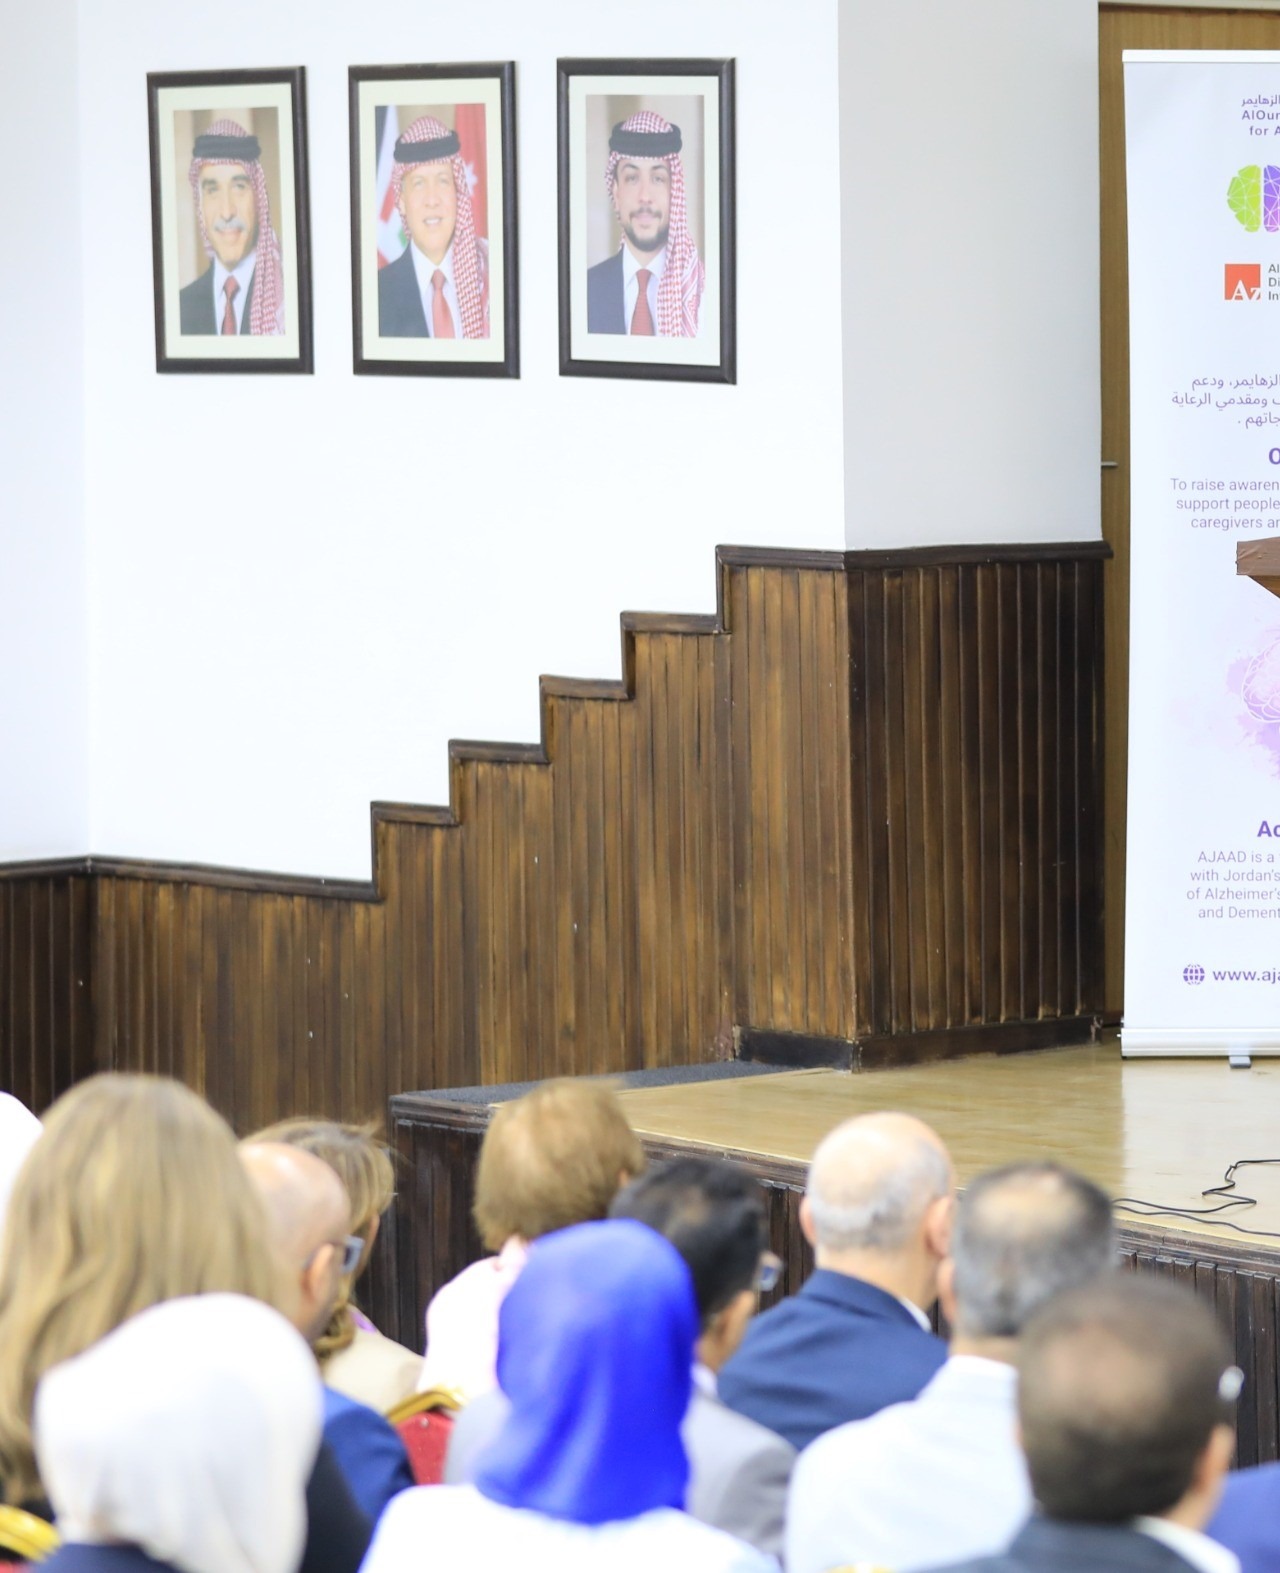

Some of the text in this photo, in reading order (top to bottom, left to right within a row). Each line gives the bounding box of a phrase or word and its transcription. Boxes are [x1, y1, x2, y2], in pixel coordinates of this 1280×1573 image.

[1241, 94, 1280, 108] الزهايمر
[1249, 125, 1269, 136] for
[1191, 374, 1224, 391] ودعم
[1171, 391, 1211, 408] الرعاية
[1215, 393, 1268, 411] ومقدمي
[1170, 478, 1187, 491] To
[1191, 478, 1225, 491] raise
[1176, 498, 1229, 513] support
[1234, 497, 1280, 513] people
[1191, 516, 1263, 531] caregivers
[1197, 851, 1247, 863] AJAAD
[1251, 850, 1262, 863] is
[1266, 853, 1275, 863] a
[1190, 869, 1219, 882] with
[1186, 888, 1201, 900] of
[1198, 906, 1224, 919] and
